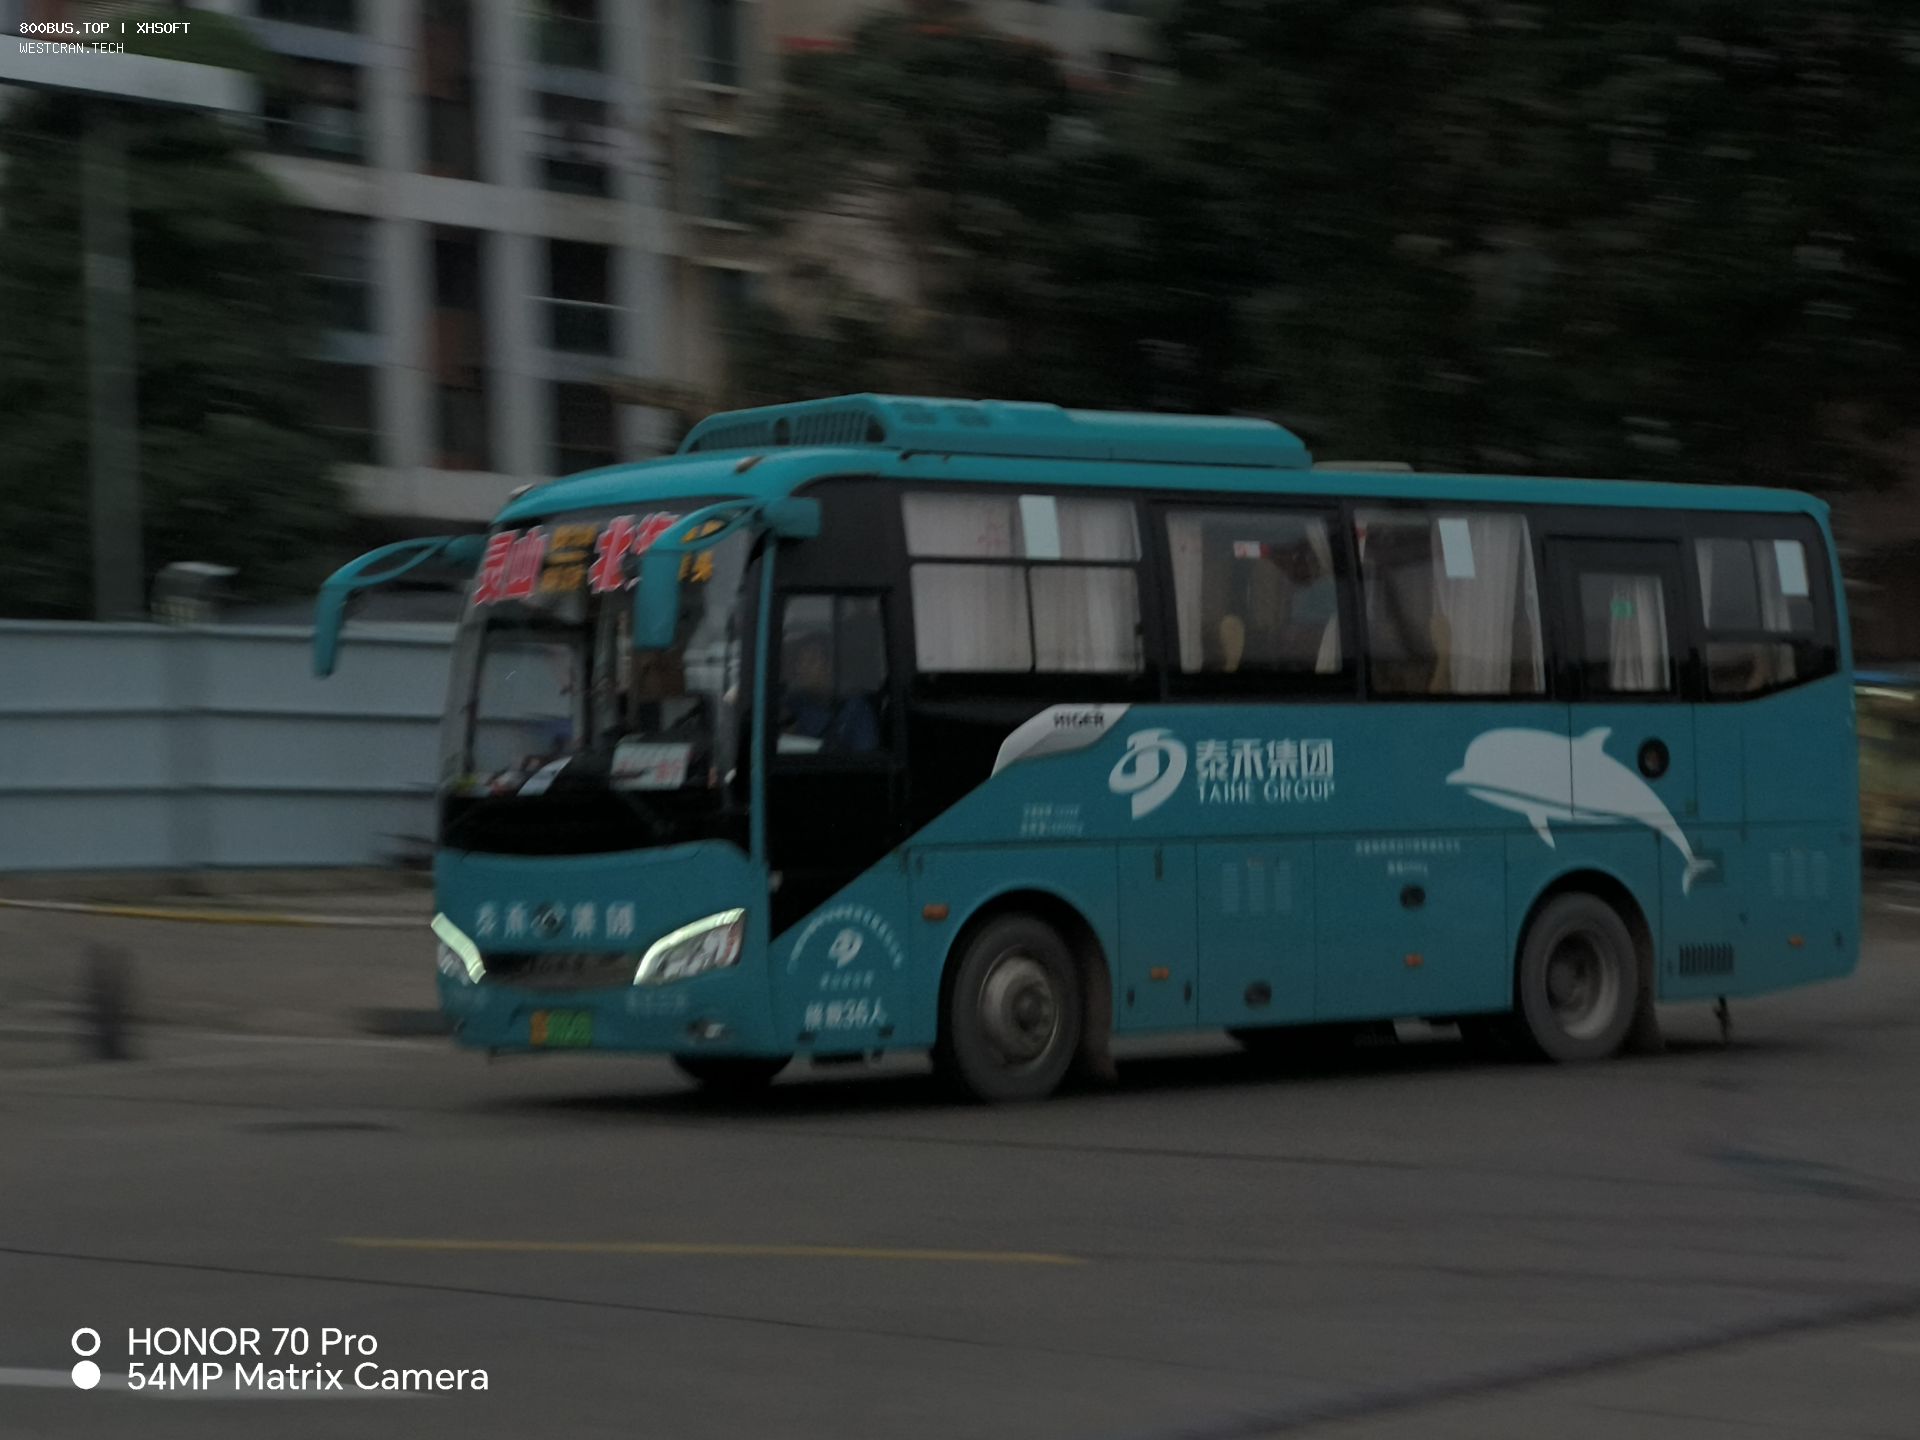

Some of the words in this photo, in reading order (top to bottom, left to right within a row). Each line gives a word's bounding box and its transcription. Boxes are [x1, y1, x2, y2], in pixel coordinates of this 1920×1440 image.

[1195, 738, 1334, 782] 泰禾集团
[1197, 779, 1256, 804] TAIHE
[1263, 777, 1335, 802] GROUP
